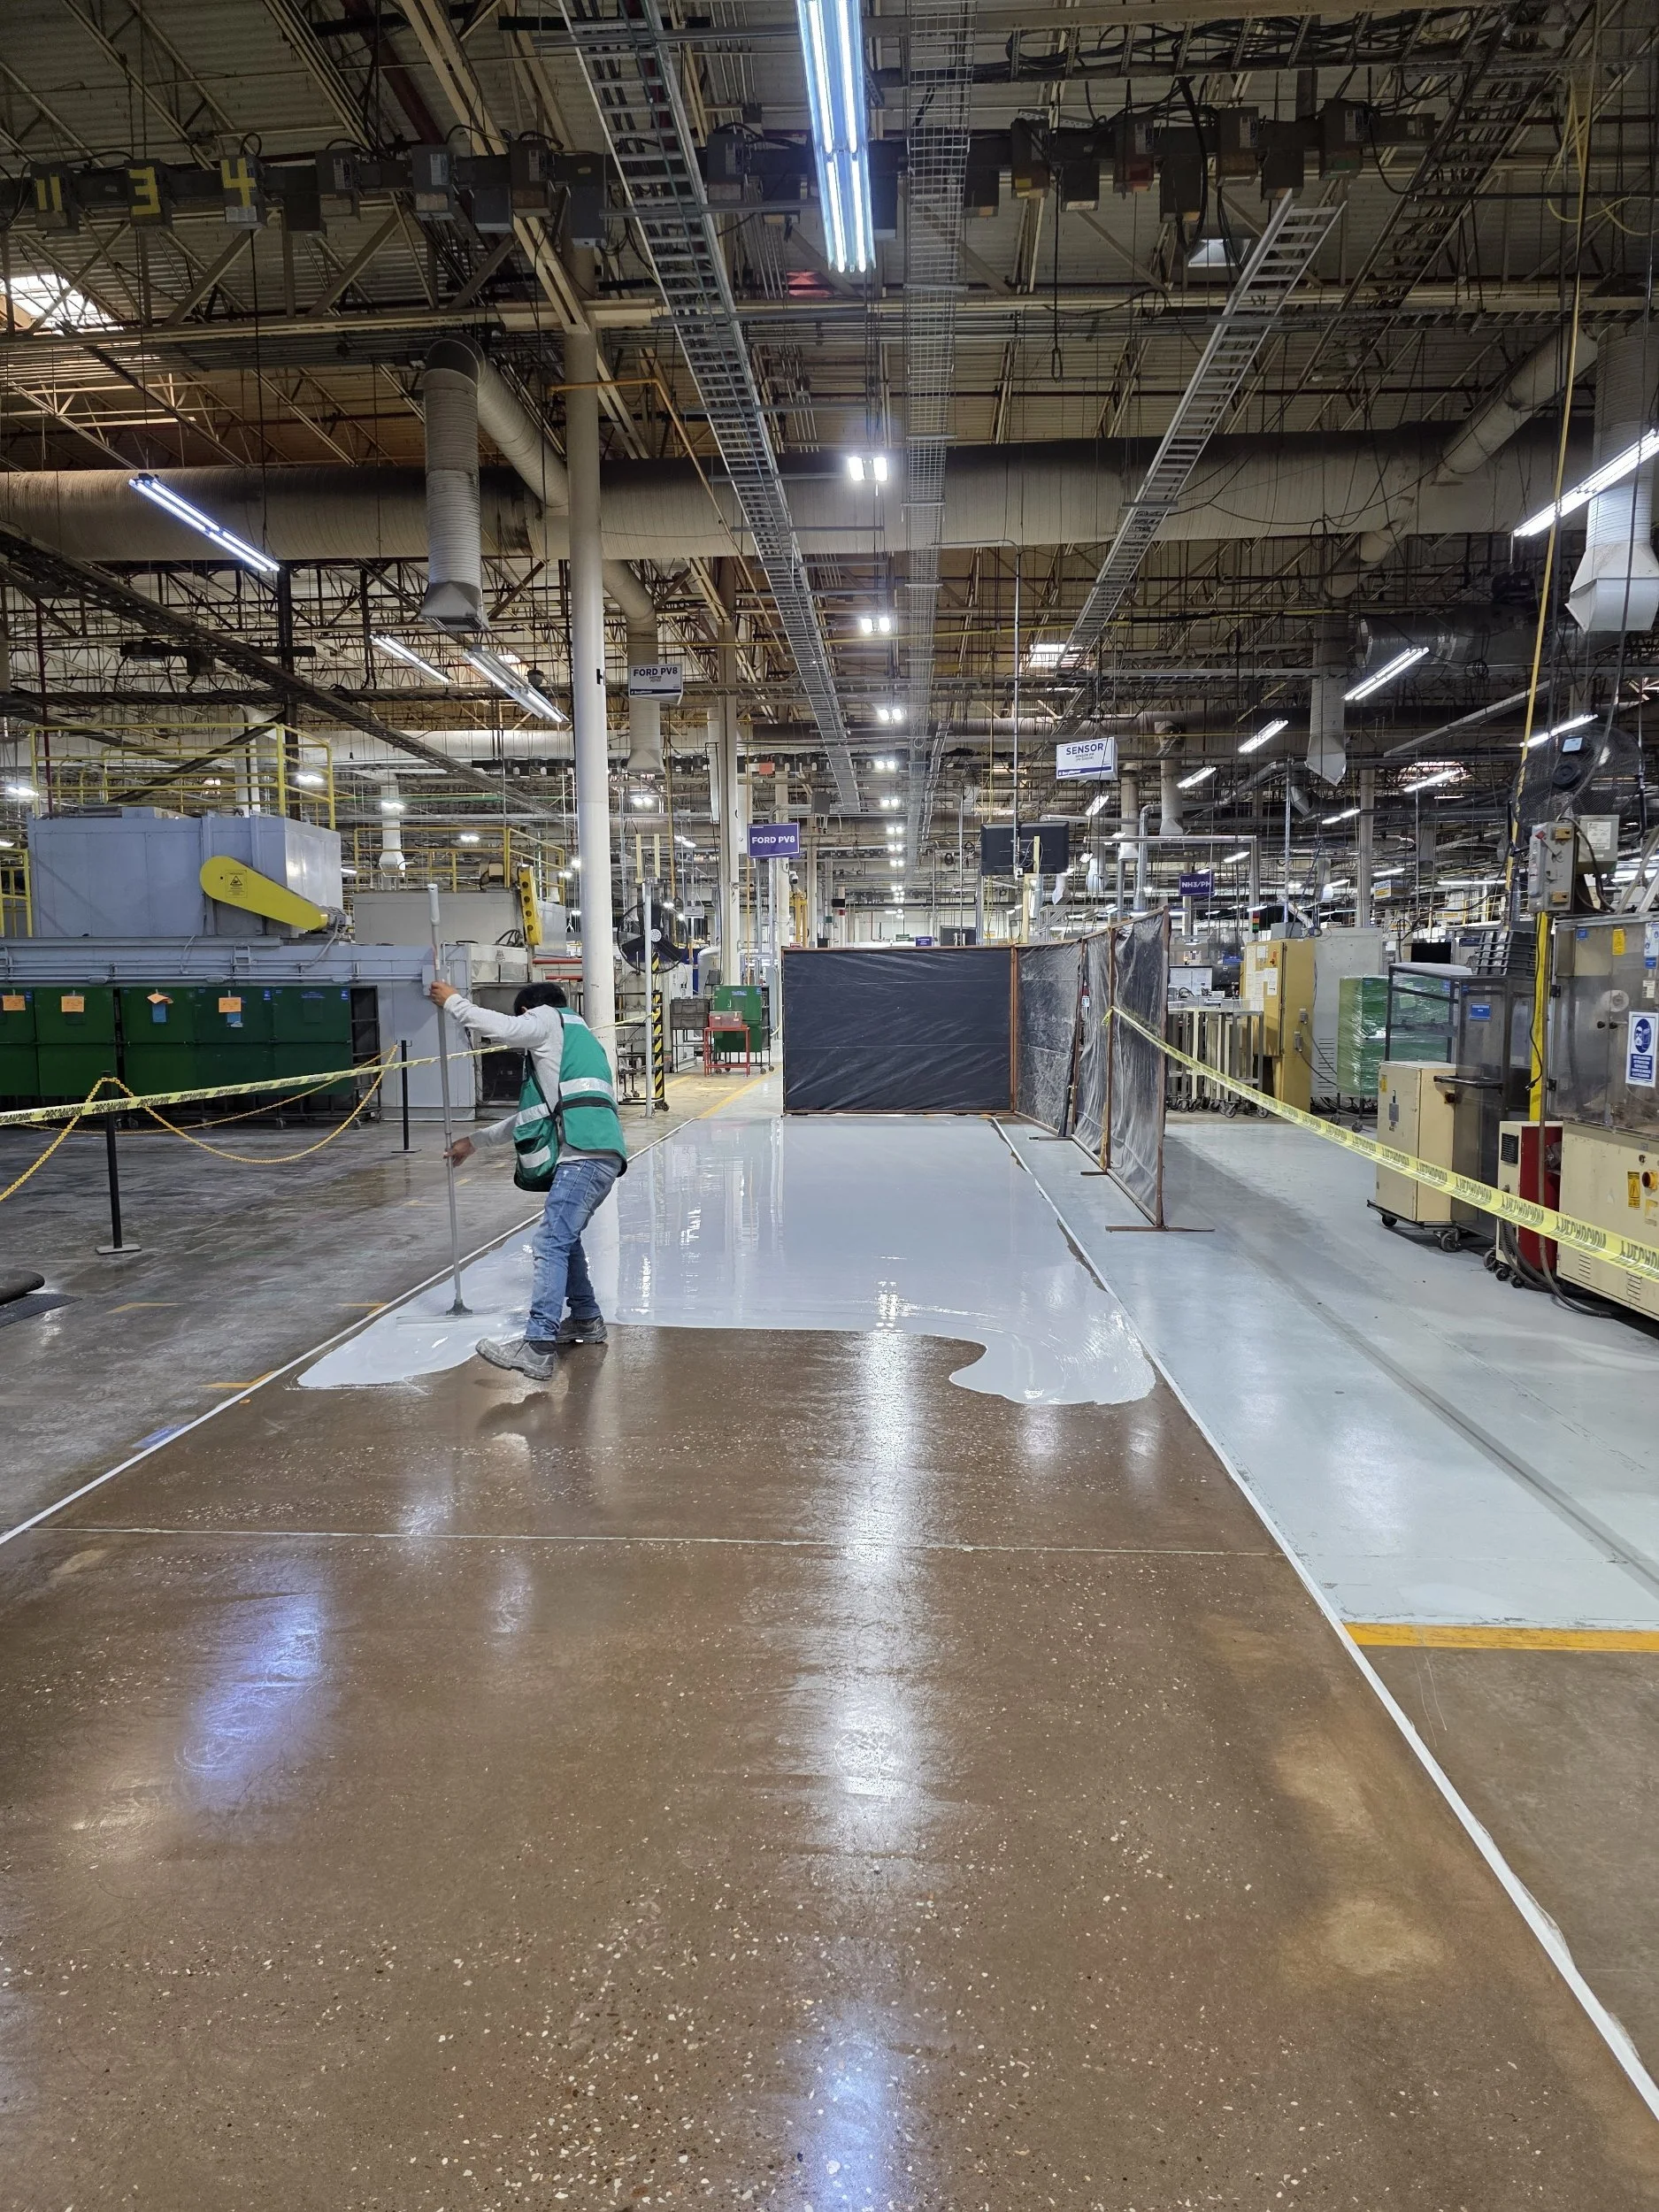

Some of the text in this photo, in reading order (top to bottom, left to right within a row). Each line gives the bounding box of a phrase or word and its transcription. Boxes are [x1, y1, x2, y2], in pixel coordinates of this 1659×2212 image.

[128, 166, 160, 215] 3
[220, 157, 257, 209] 4
[1066, 743, 1104, 756] SENSOR
